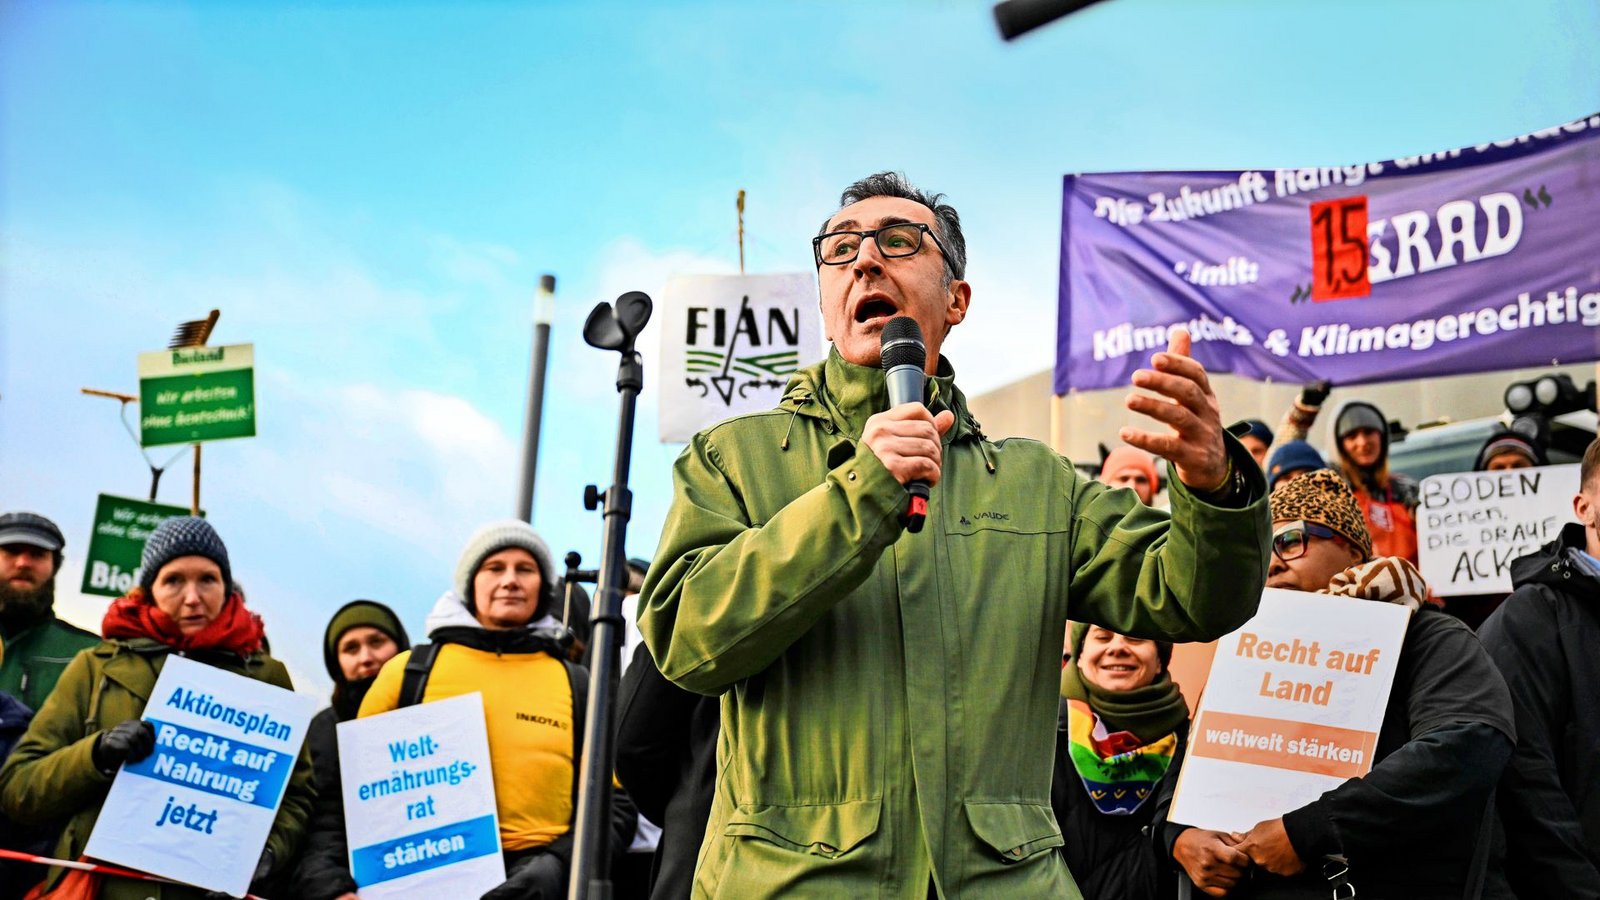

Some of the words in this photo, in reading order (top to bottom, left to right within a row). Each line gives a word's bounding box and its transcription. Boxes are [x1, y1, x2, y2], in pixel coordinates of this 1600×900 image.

[1148, 170, 1269, 223] Zukunft
[1174, 256, 1259, 286] imit:
[685, 296, 799, 347] FIAN
[1264, 329, 1292, 356] &
[1423, 472, 1541, 509] BODEN
[973, 511, 1010, 521] VAUDE
[1235, 632, 1321, 666] Recht
[1325, 648, 1381, 675] auf
[1259, 672, 1333, 706] Land
[166, 687, 292, 742] Aktionsplan
[516, 711, 560, 728] INKOTA
[156, 725, 231, 761] Recht
[232, 748, 277, 773] auf
[388, 734, 439, 763] Welt-
[1205, 727, 1283, 752] weltweit
[1287, 738, 1364, 764] stärken
[153, 754, 260, 802] Nahrung
[358, 760, 477, 801] ernährungs-
[156, 796, 218, 835] jetzt
[406, 795, 435, 821] rat
[383, 834, 465, 870] stärken
